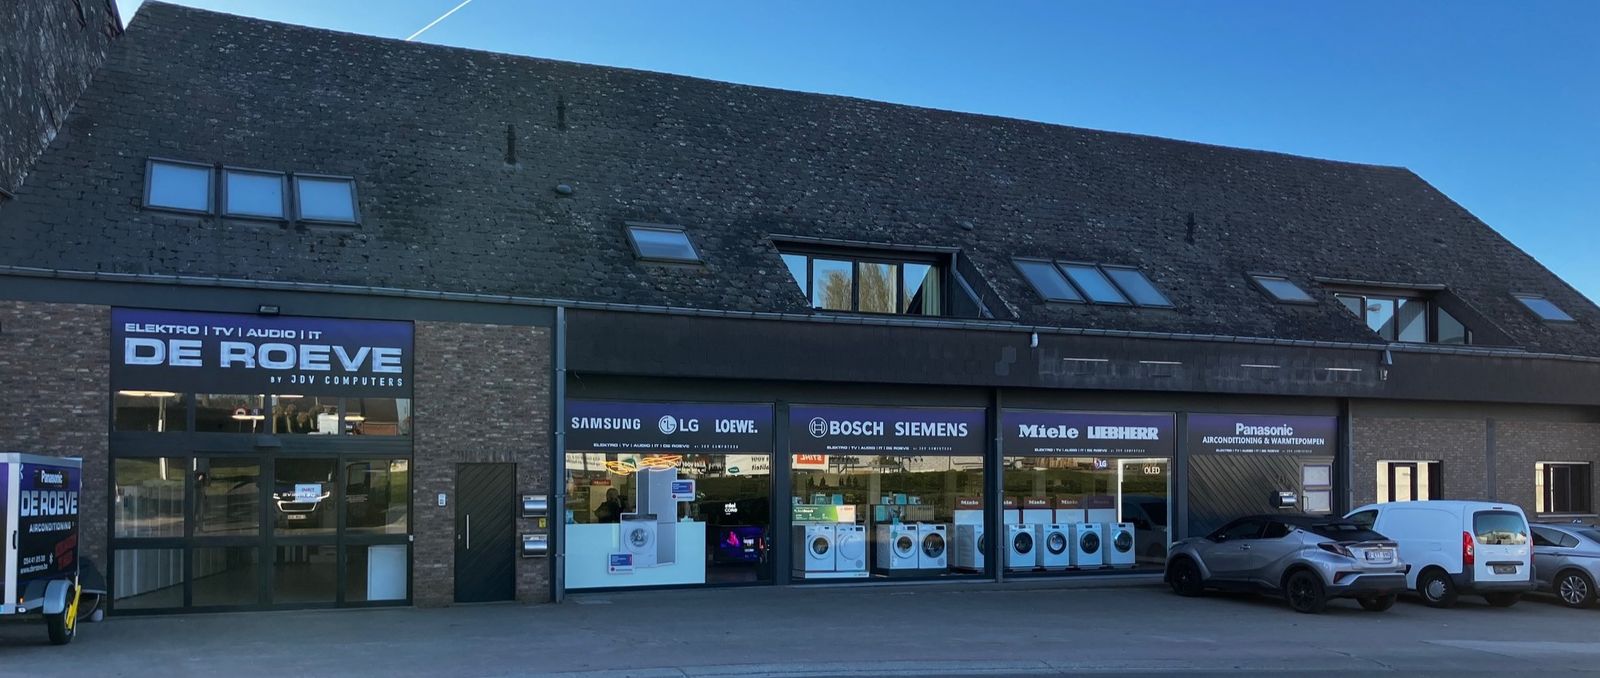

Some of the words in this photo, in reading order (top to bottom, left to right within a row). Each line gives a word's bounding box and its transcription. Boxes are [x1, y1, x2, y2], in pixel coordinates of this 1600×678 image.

[124, 323, 200, 335] ELEKTRO
[213, 327, 234, 336] TV
[246, 328, 296, 339] AUDIO
[308, 330, 322, 340] IT
[124, 337, 203, 367] DE
[220, 340, 403, 373] ROEVE
[290, 375, 316, 384] JDV
[325, 376, 403, 386] COMPUTERS
[571, 417, 641, 430] SAMSUNG
[680, 419, 699, 432] LG
[830, 420, 884, 436] BOSCH
[895, 422, 968, 437] SIEMENS
[1236, 422, 1293, 436] Panasonic
[1018, 424, 1079, 439] Miele
[1087, 426, 1159, 440] LIEBHERR
[1202, 436, 1262, 445] AIRCONDITIONING
[1271, 437, 1324, 446] WARMTEPOMPEN
[41, 470, 63, 485] Panasonic
[1144, 466, 1160, 475] OLED
[21, 490, 38, 517] DE
[40, 490, 77, 516] ROEVE
